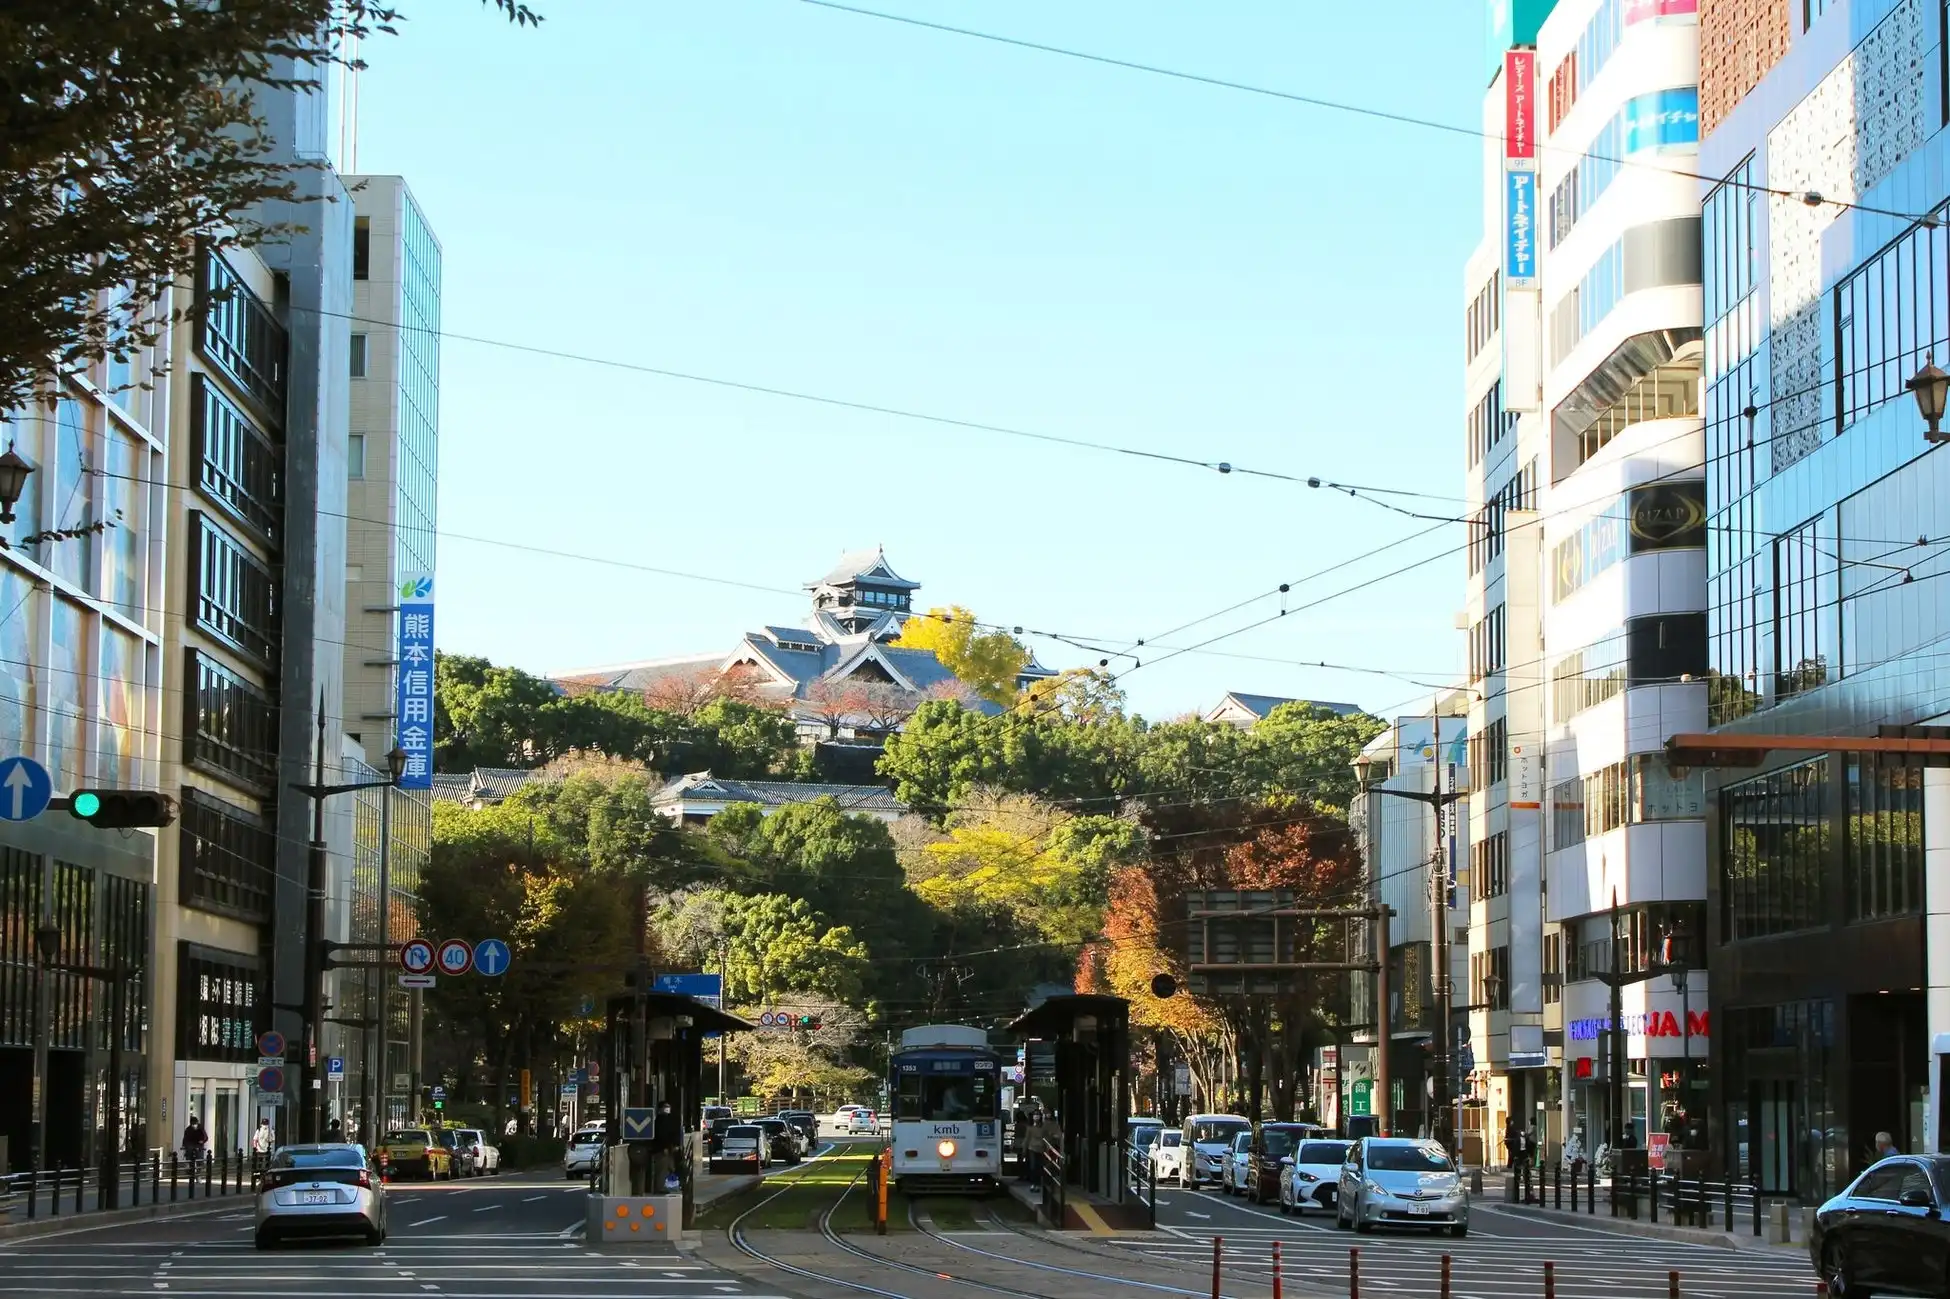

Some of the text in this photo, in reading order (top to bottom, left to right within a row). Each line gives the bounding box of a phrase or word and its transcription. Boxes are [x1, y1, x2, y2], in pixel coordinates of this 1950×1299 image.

[1514, 159, 1526, 168] 9F
[1512, 175, 1530, 274] アートネイチャー
[402, 613, 430, 779] 熊本信用金庫
[1519, 757, 1529, 799] ホットヨガ
[445, 949, 465, 965] 40
[1645, 1010, 1709, 1038] JAM
[331, 1059, 341, 1071] P
[1355, 1081, 1367, 1112] 商工
[933, 1123, 960, 1135] kmb
